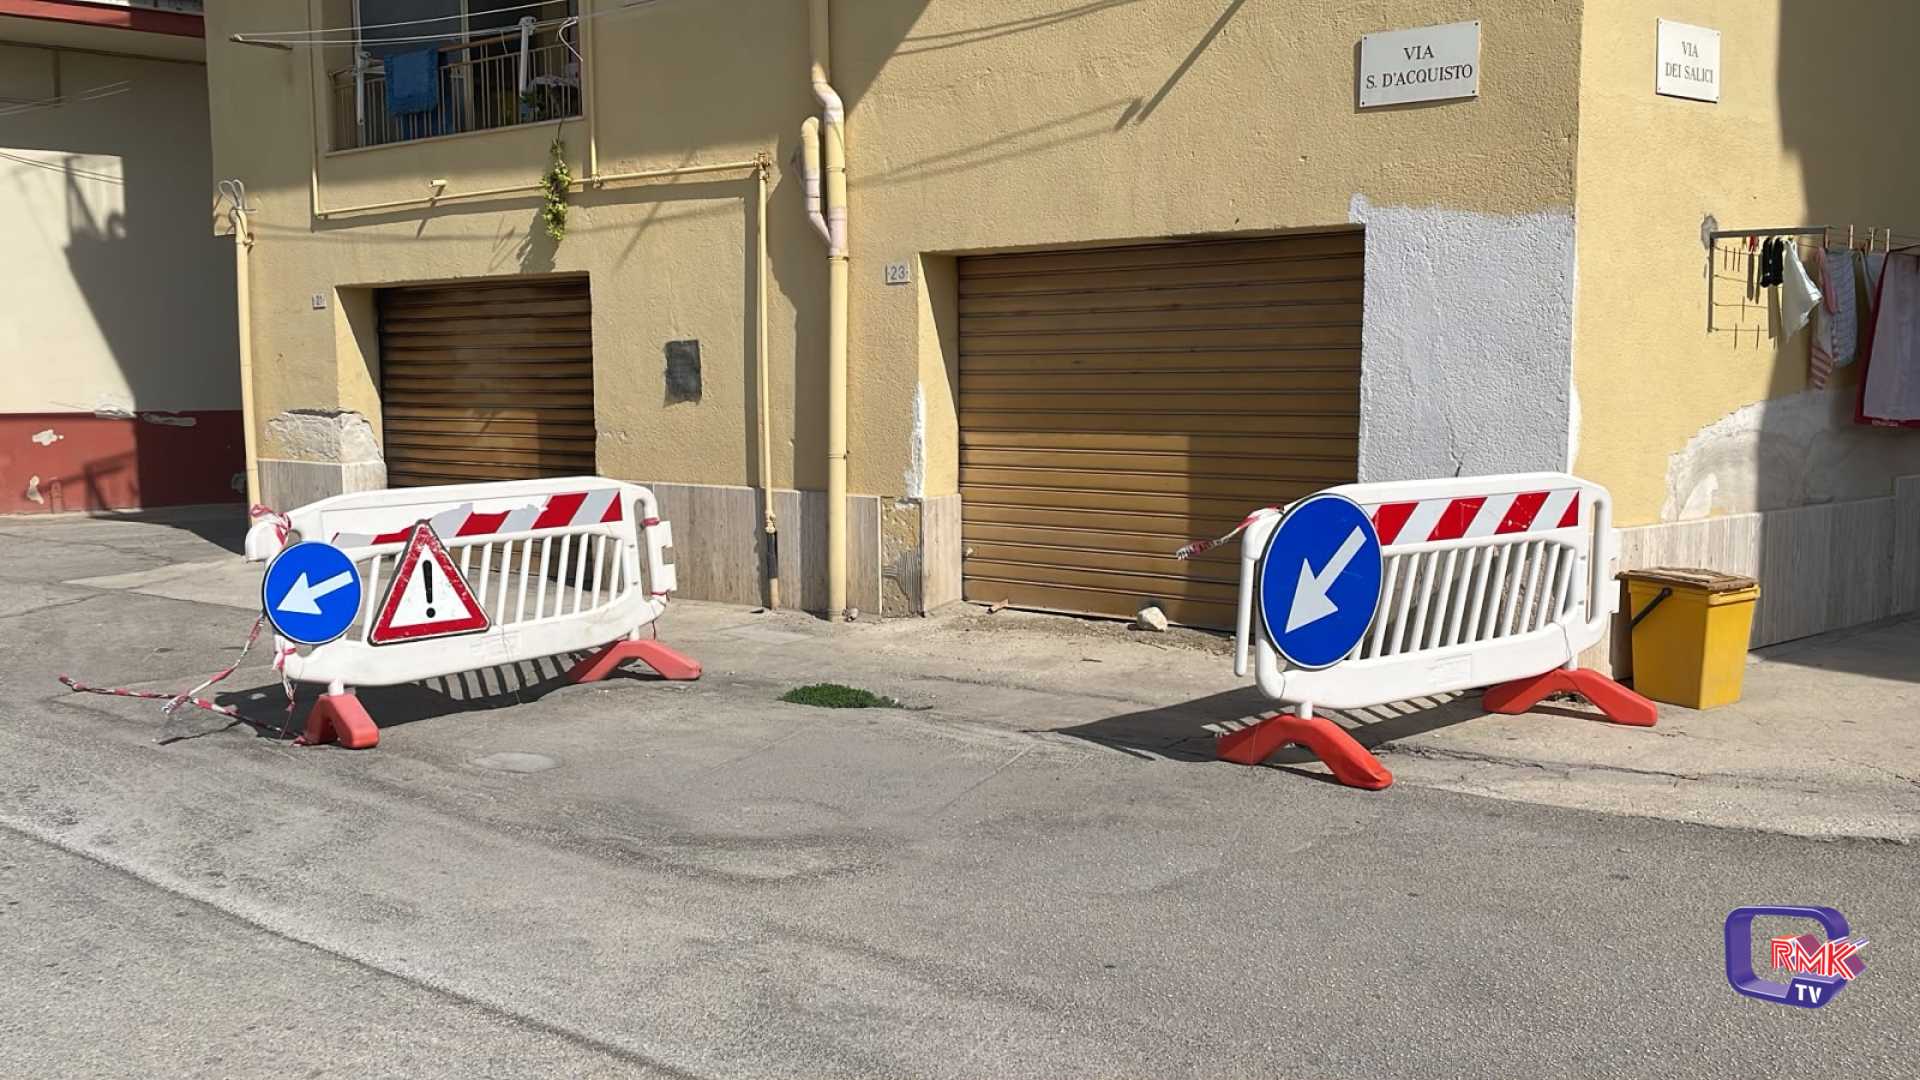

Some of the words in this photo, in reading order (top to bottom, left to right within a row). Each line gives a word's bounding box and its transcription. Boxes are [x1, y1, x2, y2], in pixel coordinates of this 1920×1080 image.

[1403, 44, 1435, 61] VIA
[1681, 40, 1699, 58] VIA
[1366, 75, 1378, 89] S.
[1382, 64, 1473, 88] D'ACQUISTO
[1665, 62, 1682, 79] DEI
[1684, 65, 1713, 84] SALICI
[890, 265, 906, 281] 23
